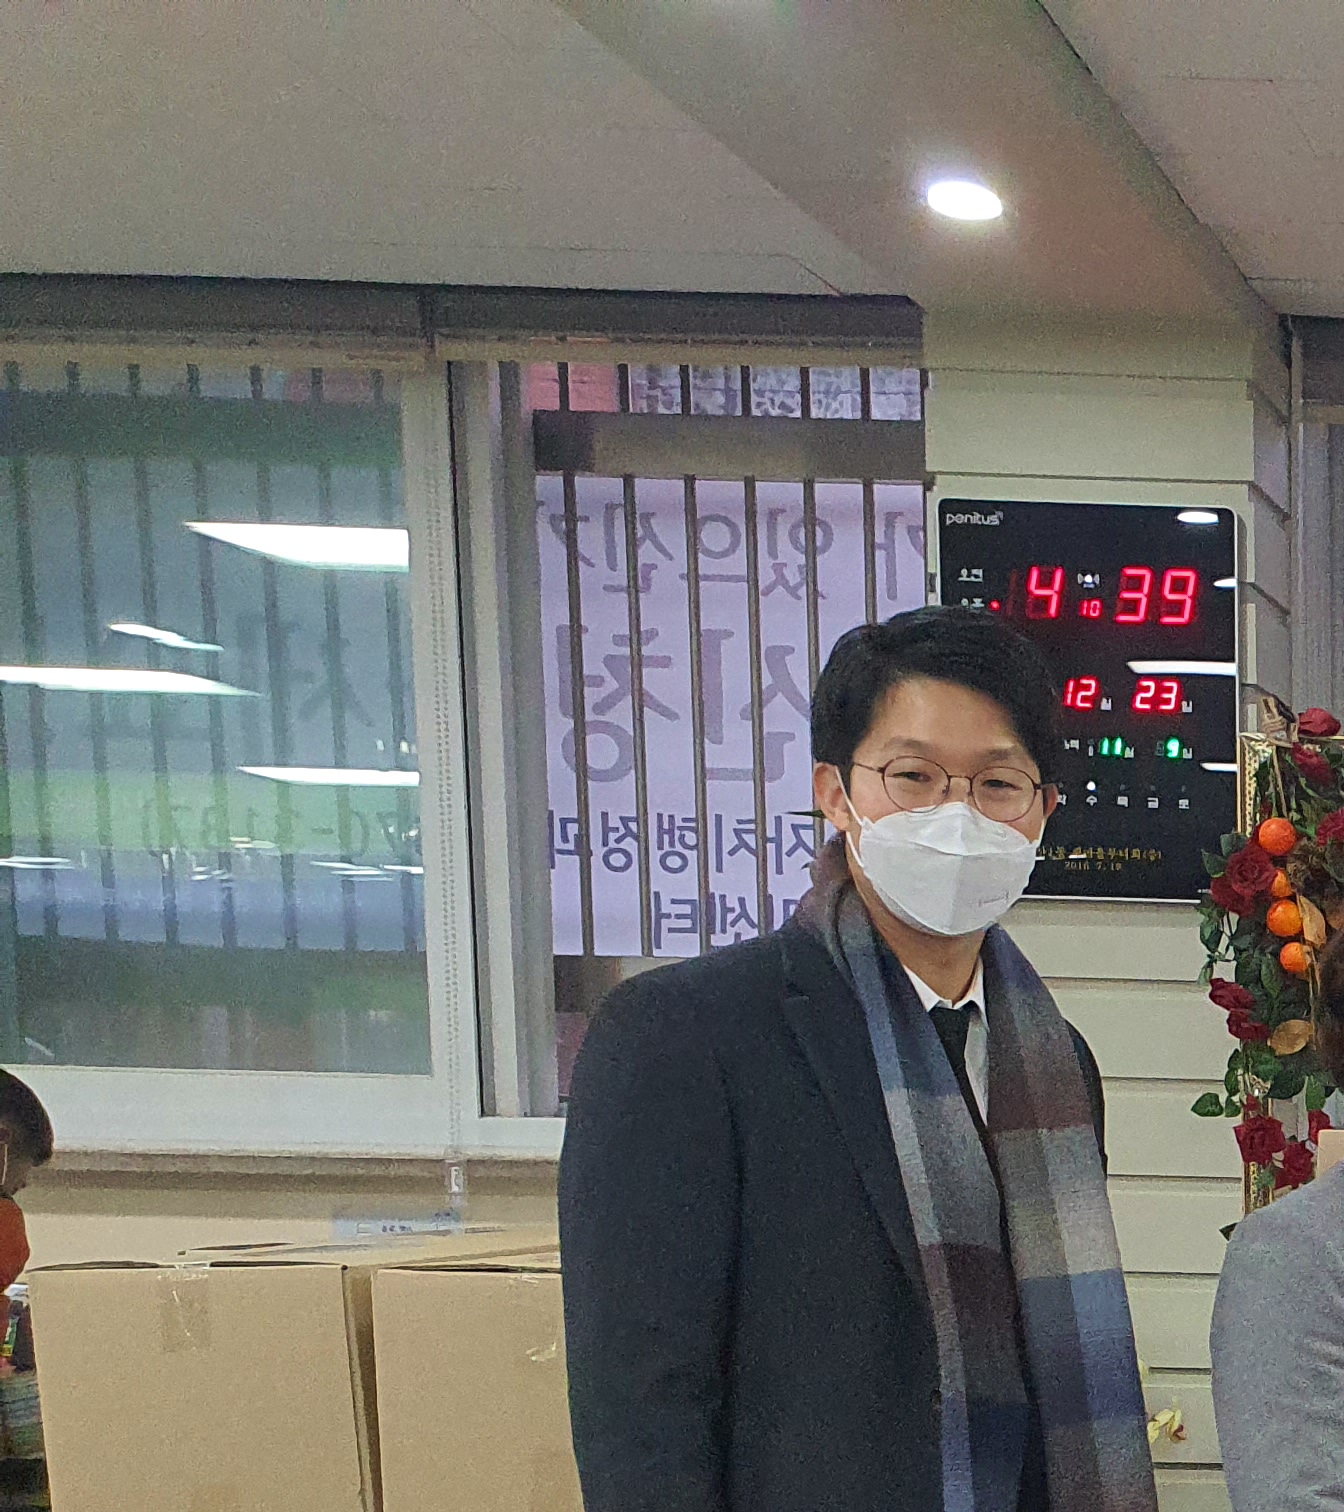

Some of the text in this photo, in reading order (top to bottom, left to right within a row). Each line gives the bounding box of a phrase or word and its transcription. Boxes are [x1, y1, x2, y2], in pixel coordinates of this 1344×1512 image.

[1115, 565, 1199, 626] 39
[1064, 676, 1099, 711] 12
[1132, 678, 1183, 713] 23
